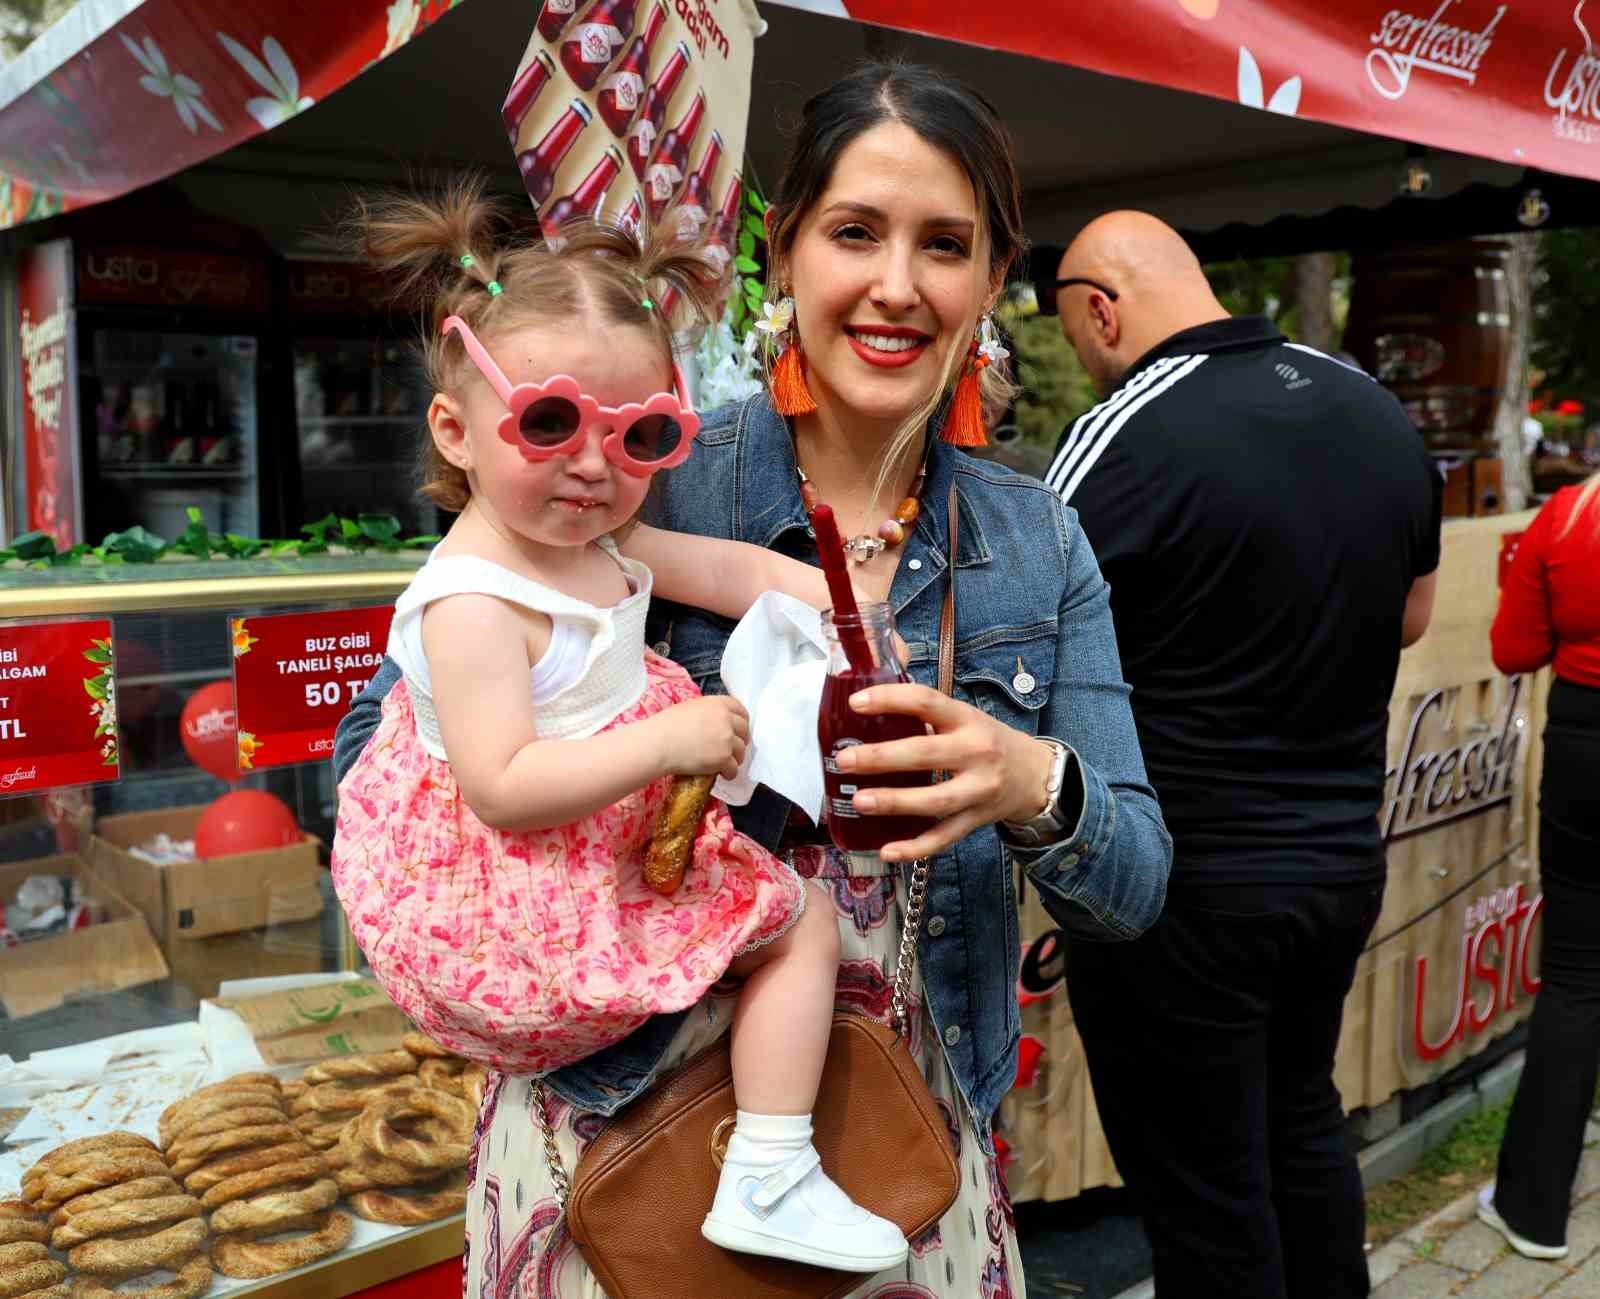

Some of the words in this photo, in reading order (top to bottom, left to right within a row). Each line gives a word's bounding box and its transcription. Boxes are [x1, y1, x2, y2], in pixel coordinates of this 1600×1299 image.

[306, 638, 336, 652] BUZ
[340, 632, 370, 649] GİBİ
[0, 666, 46, 679] LGAM
[277, 654, 331, 674] TANELİ
[334, 652, 387, 673] ŞALGA
[305, 682, 340, 707] 50
[0, 719, 26, 739] TL
